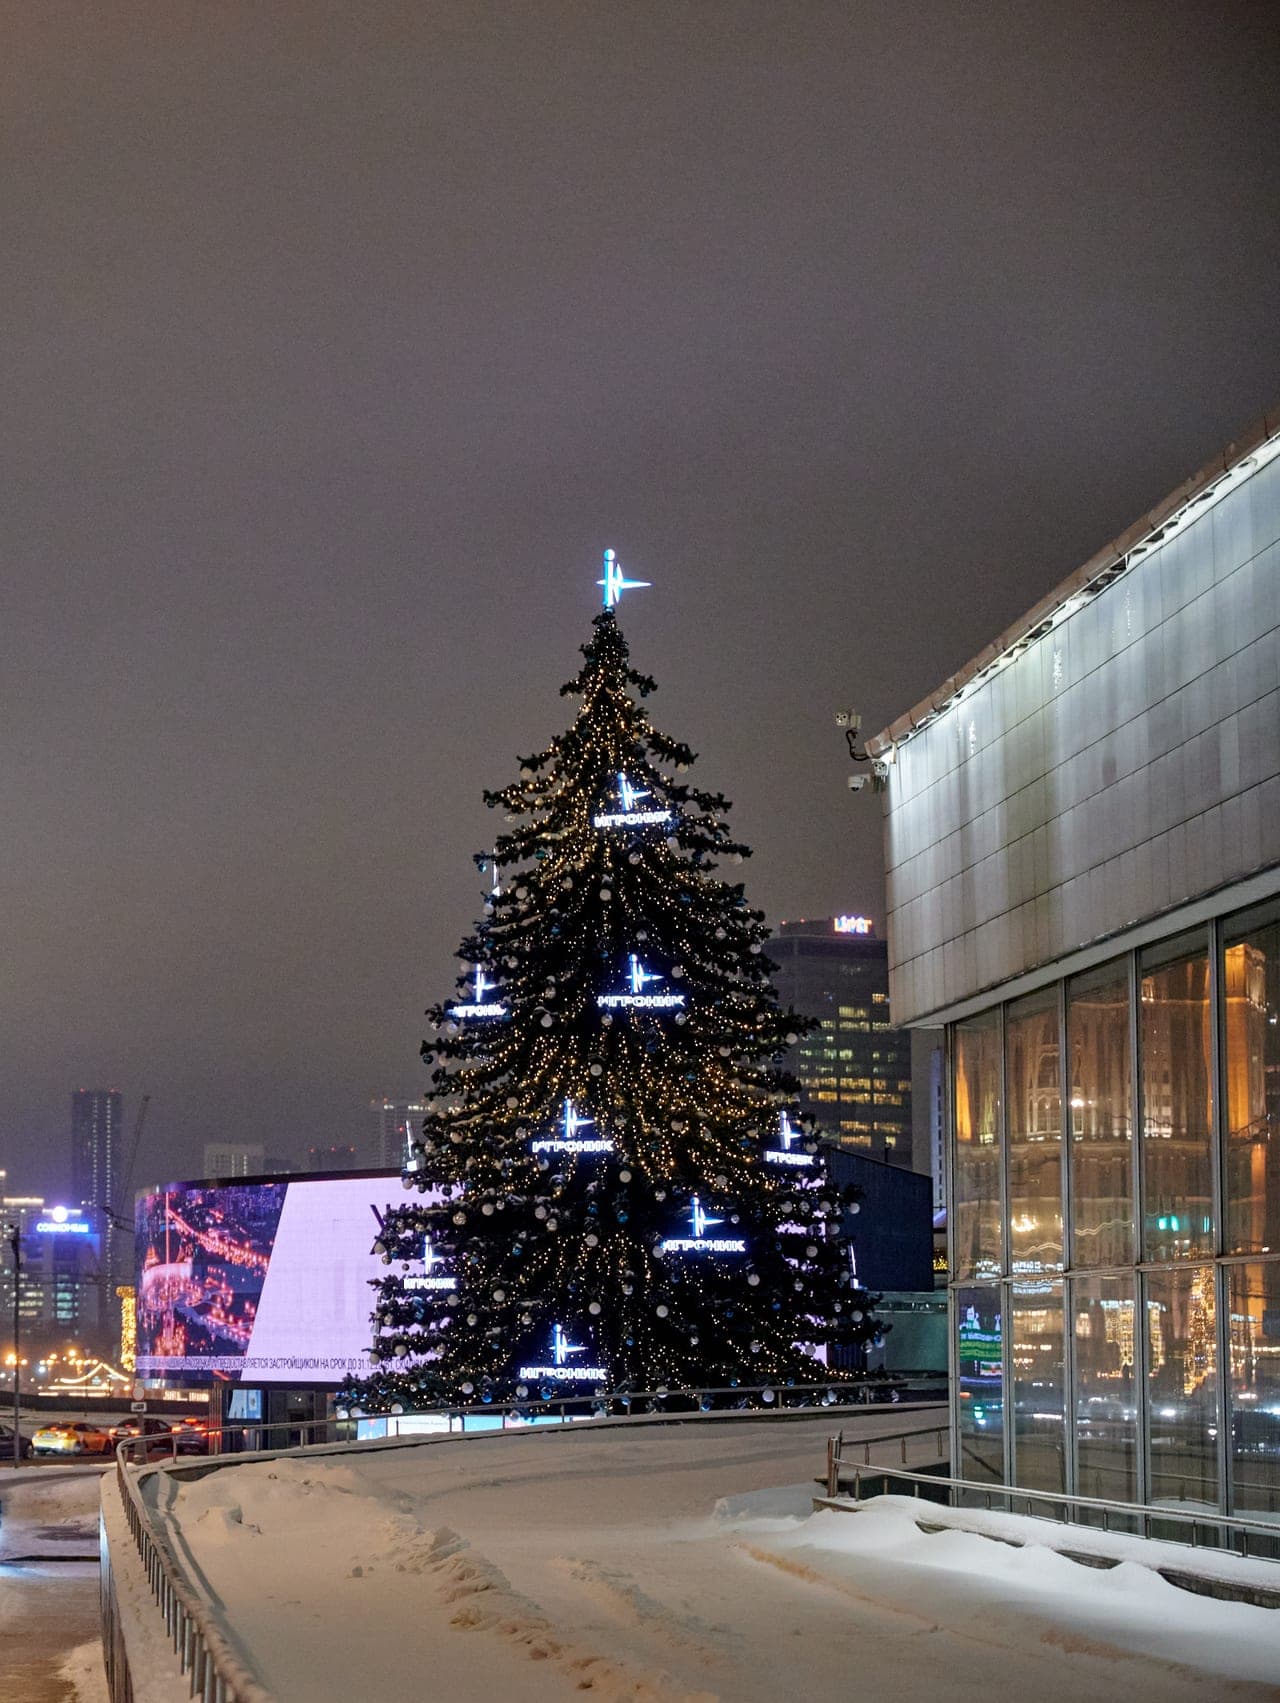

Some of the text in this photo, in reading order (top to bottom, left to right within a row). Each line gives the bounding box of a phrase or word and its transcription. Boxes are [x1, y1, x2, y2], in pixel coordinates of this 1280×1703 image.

[269, 1356, 319, 1371] ЗАСТРОЙЩИКОМ
[321, 1359, 329, 1369] НА
[330, 1359, 346, 1369] СРОК
[348, 1359, 357, 1370] ДО
